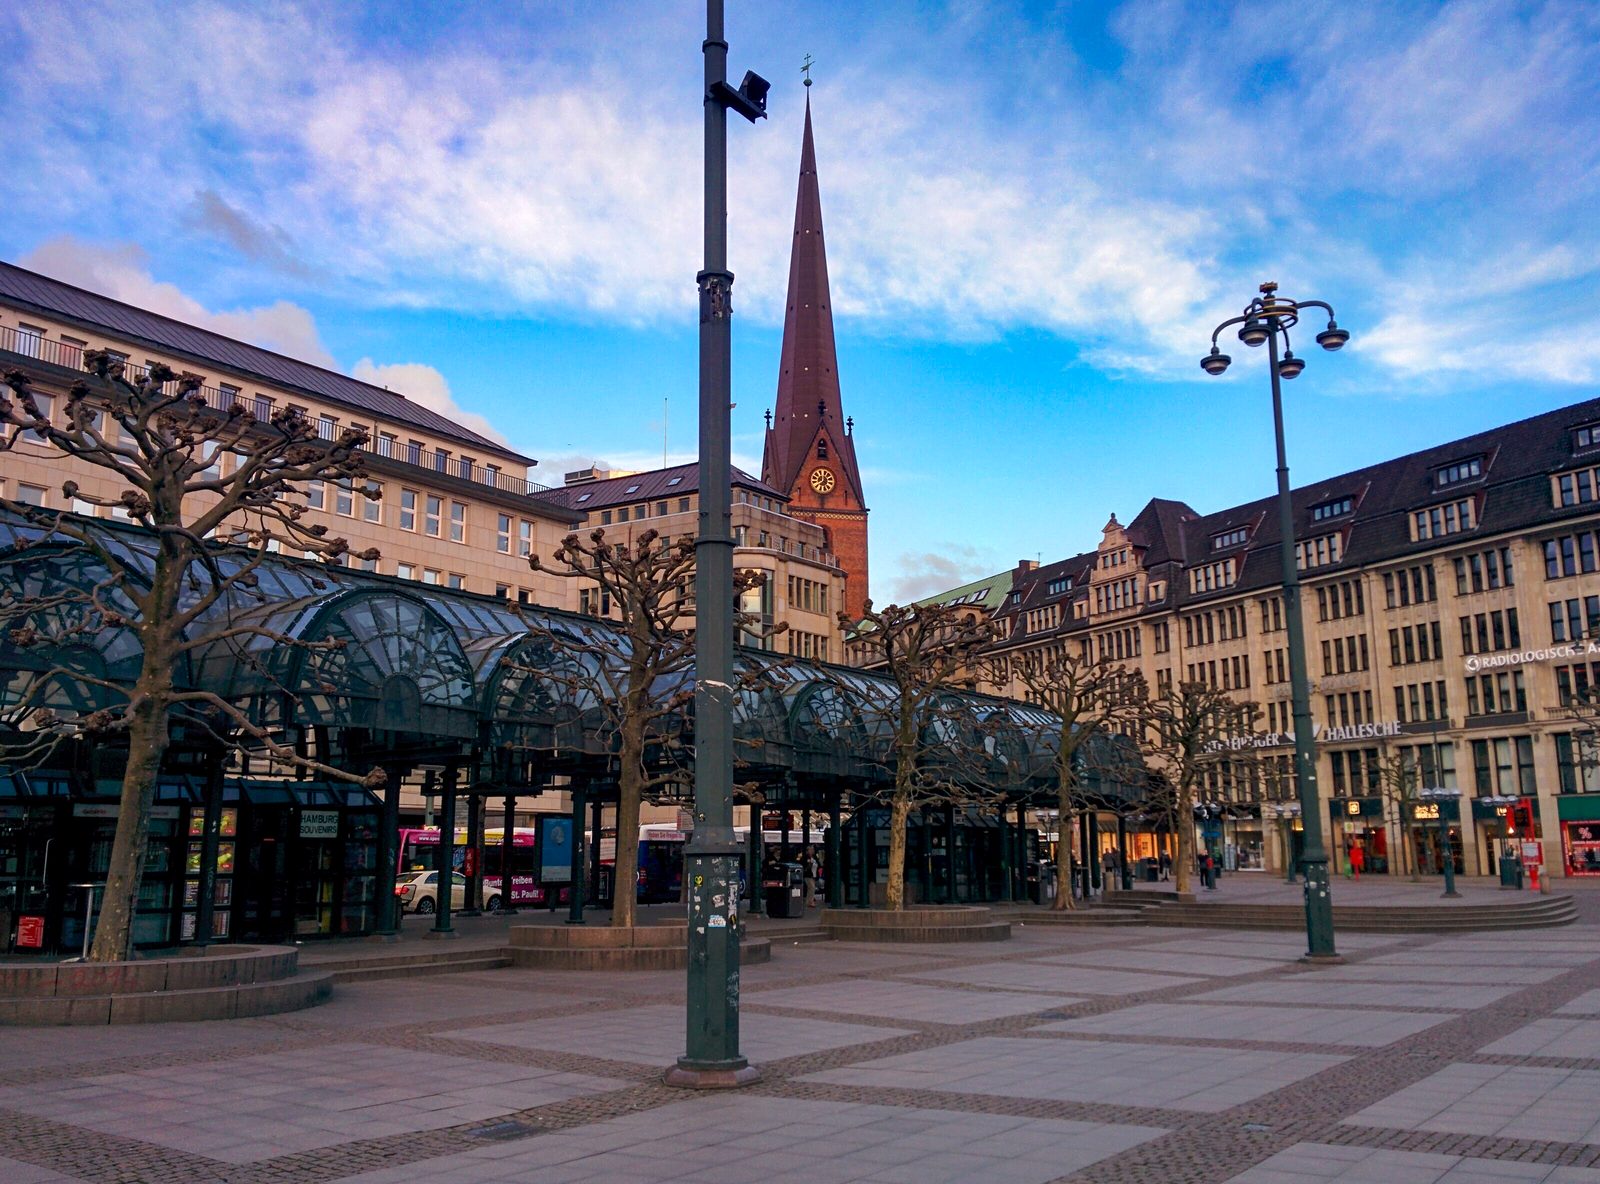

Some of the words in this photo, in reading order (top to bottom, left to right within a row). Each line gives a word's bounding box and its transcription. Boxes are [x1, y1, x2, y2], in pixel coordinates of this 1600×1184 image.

[1482, 645, 1585, 668] RADIOLOGISCH
[1327, 720, 1402, 741] HALLESCHE
[301, 814, 339, 824] HAMBURG
[300, 825, 337, 834] SOUVENIRS
[511, 875, 533, 885] reiben
